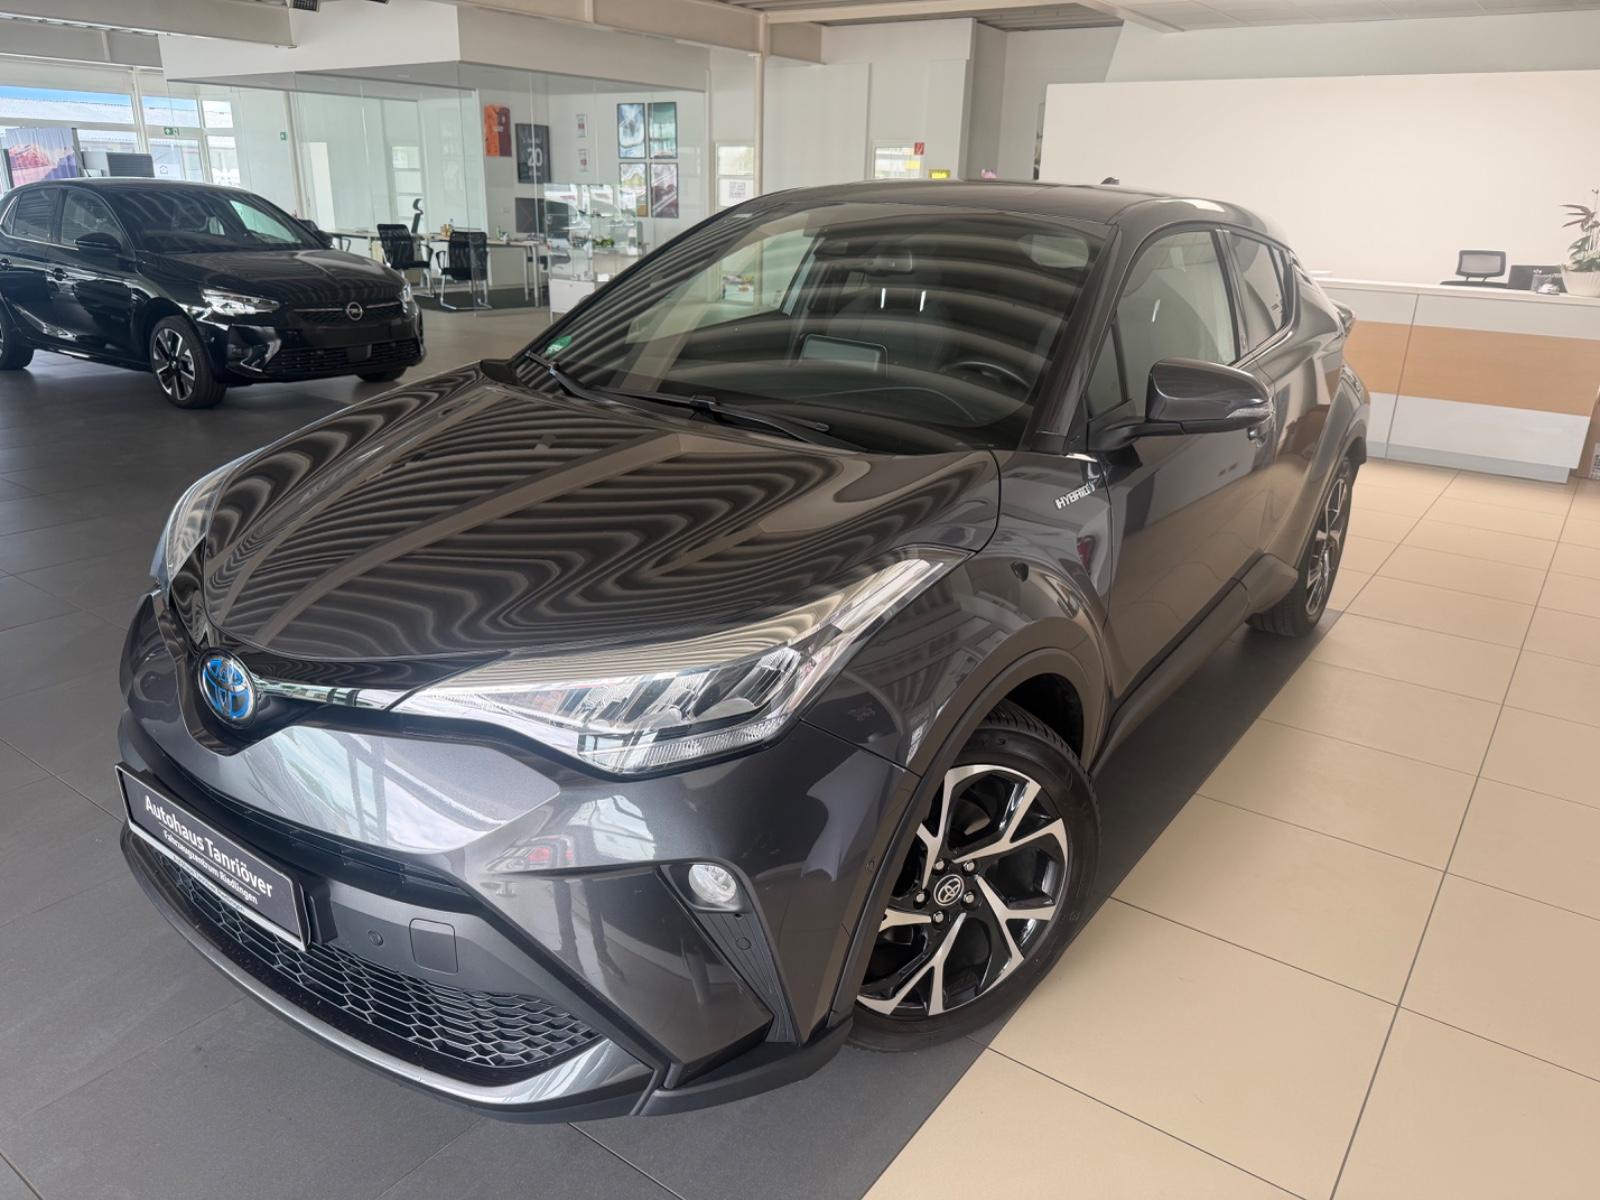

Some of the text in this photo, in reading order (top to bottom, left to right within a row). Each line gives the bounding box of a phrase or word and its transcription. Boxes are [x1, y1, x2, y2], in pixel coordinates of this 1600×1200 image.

[527, 147, 543, 167] 20
[1055, 483, 1091, 509] HYBRID
[145, 796, 204, 852] Autohaus
[204, 838, 273, 898] Tanriöver
